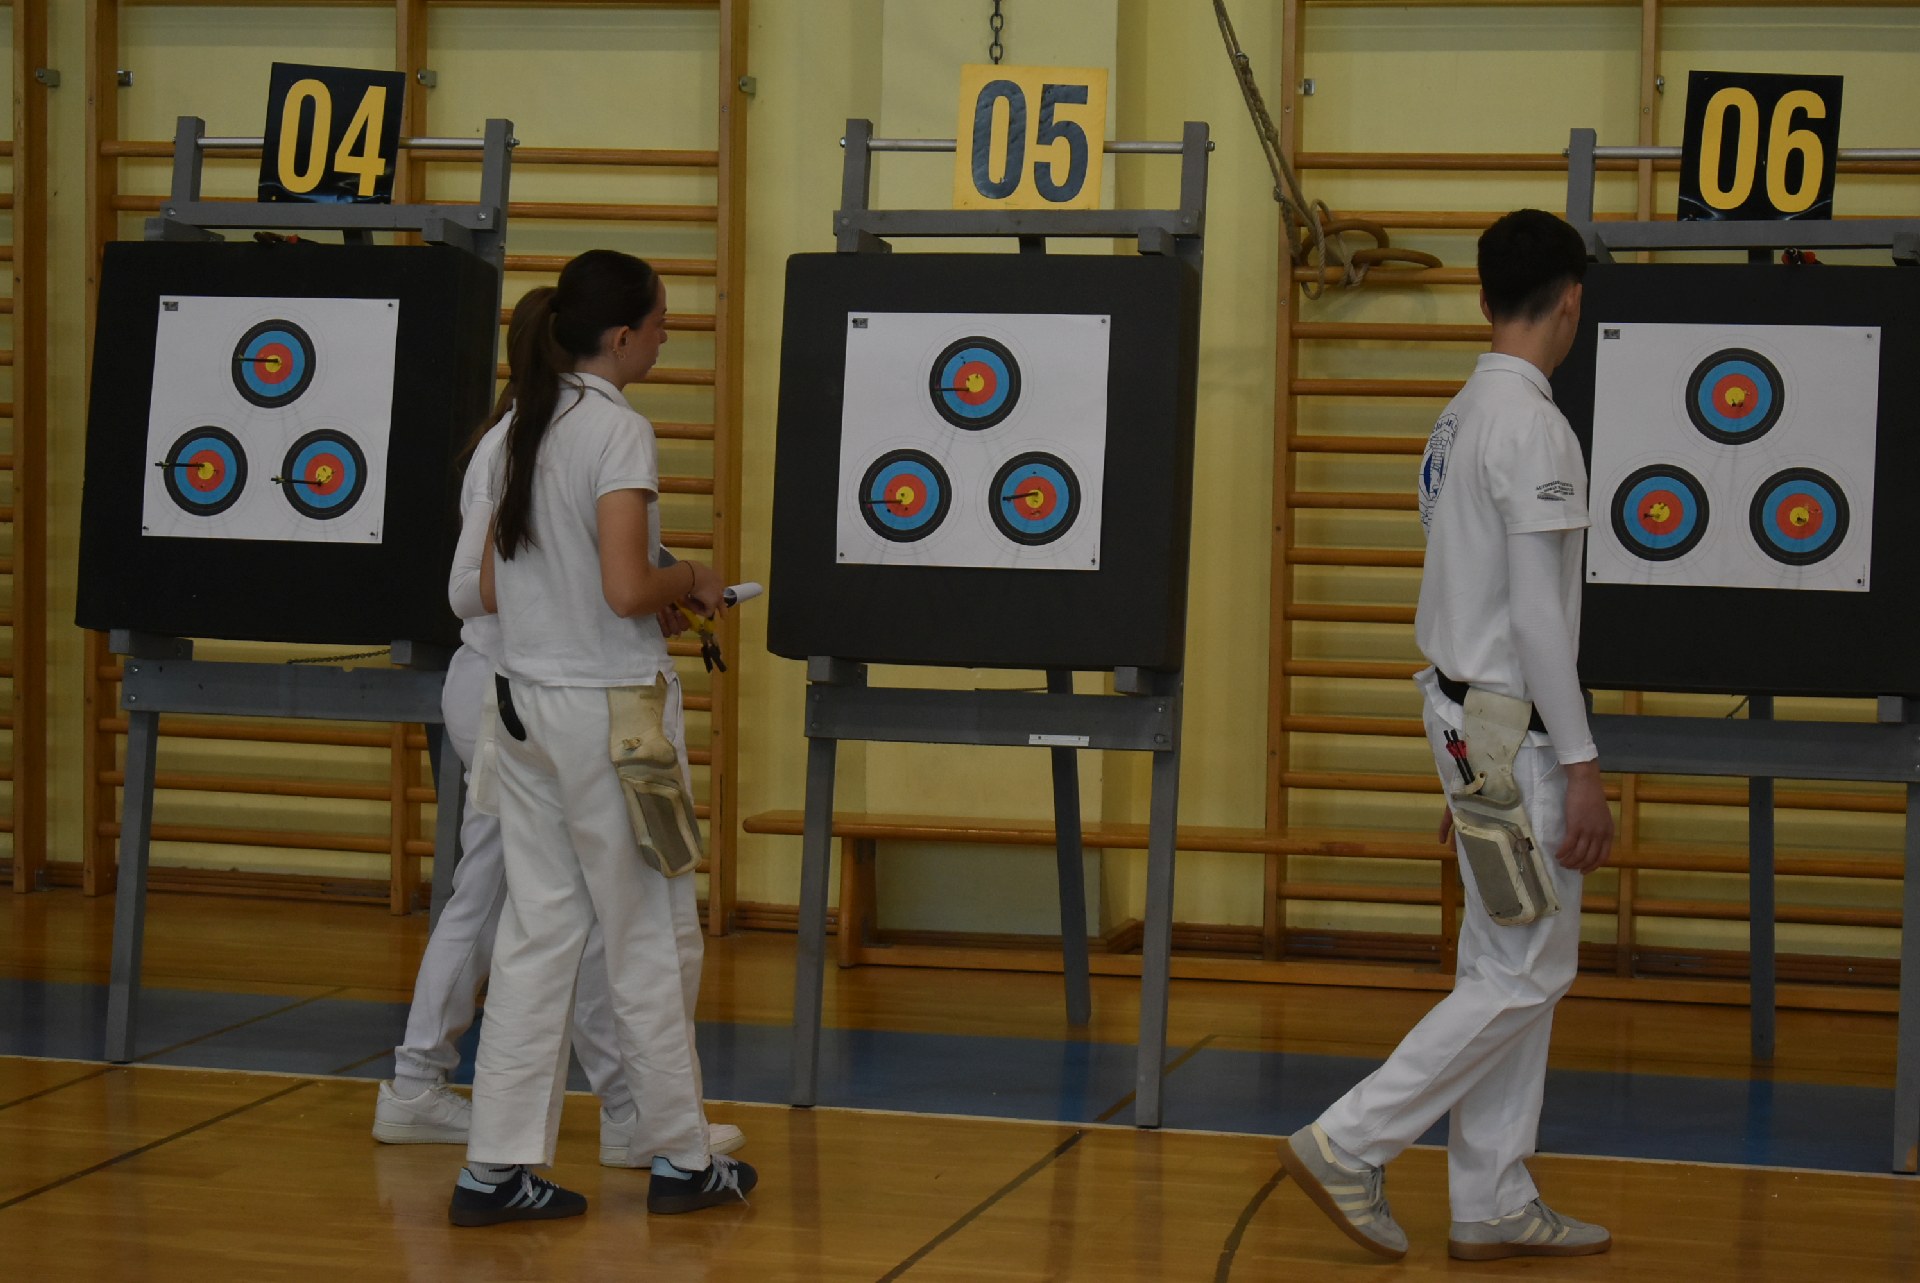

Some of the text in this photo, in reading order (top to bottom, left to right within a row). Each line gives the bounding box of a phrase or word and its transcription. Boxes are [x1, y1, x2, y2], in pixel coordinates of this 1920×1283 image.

[279, 80, 386, 196] 04
[970, 79, 1090, 204] 05
[1700, 88, 1825, 212] 06
